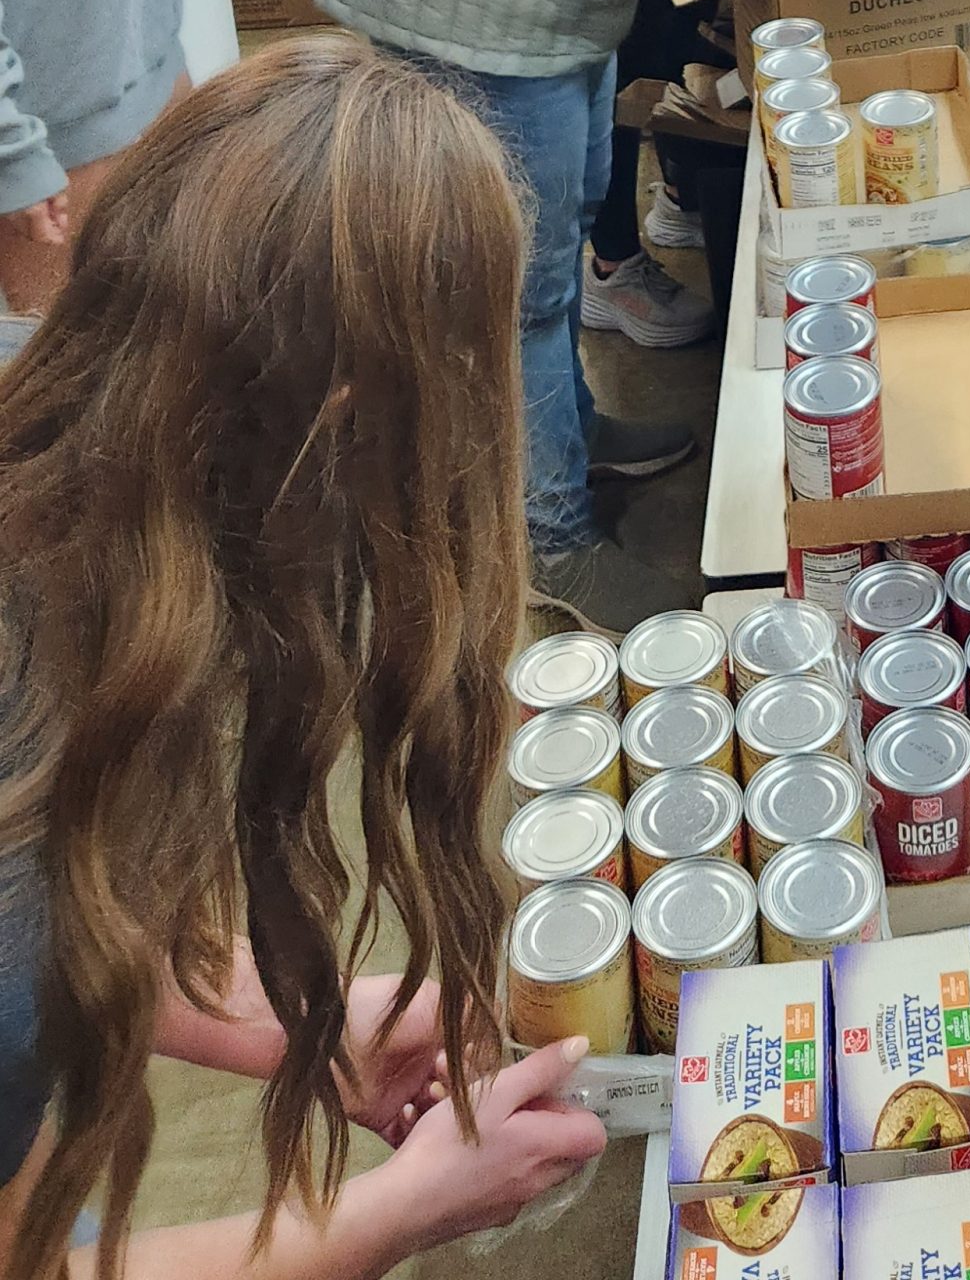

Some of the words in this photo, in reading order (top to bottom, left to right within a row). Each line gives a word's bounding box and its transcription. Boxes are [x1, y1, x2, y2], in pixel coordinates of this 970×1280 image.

[845, 34, 906, 56] FACTORY
[909, 26, 945, 44] CODE
[816, 445, 828, 453] 25
[897, 817, 958, 845] DICED
[898, 836, 959, 857] TOMATOES
[885, 1004, 902, 1070] TRADITIONAL
[904, 993, 926, 1077] VARIETY
[923, 1004, 944, 1058] PACK
[723, 1034, 739, 1103] TRADITIONAL
[744, 1023, 763, 1110] VARIETY
[764, 1036, 782, 1091] PACK
